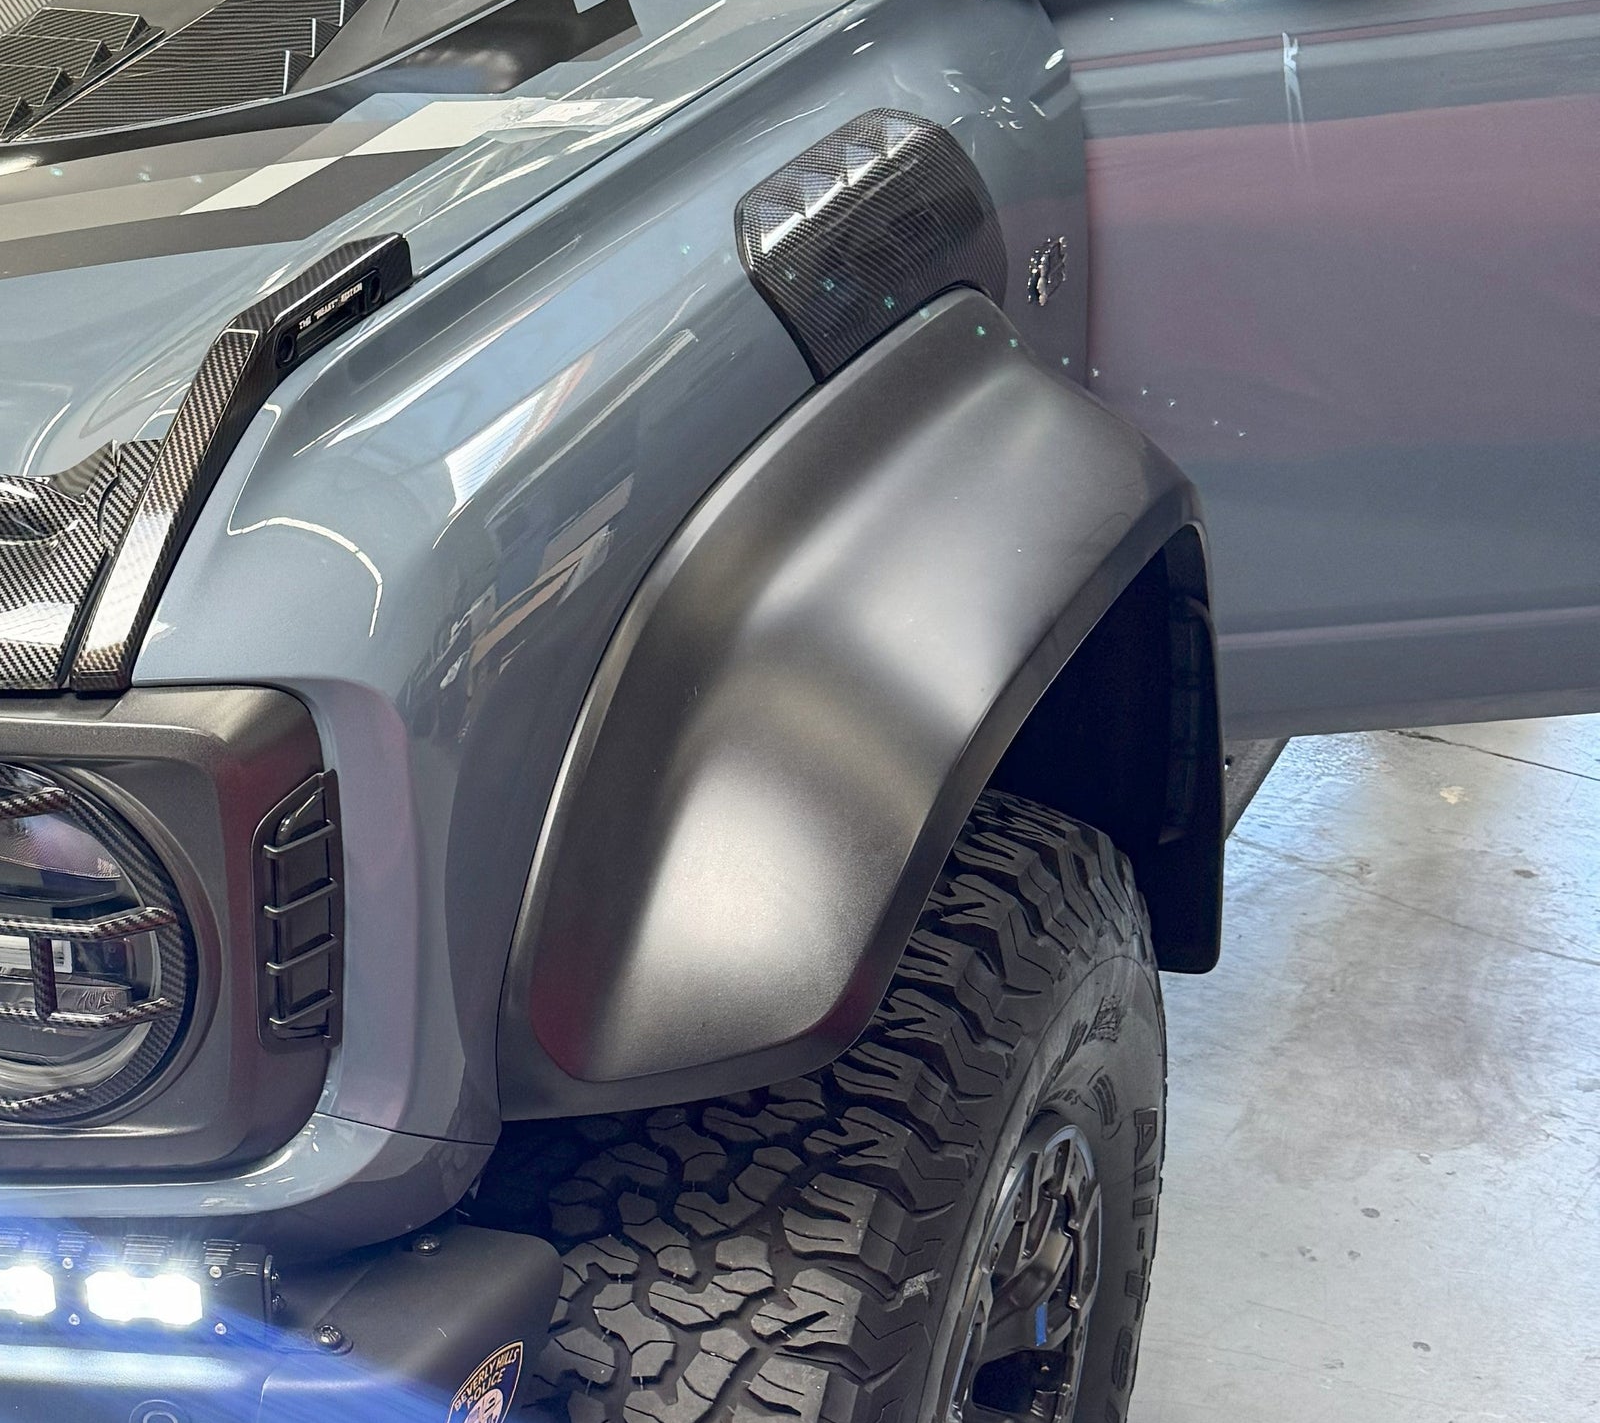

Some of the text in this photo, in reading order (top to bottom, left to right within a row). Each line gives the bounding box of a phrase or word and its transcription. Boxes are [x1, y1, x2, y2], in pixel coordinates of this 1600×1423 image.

[453, 1348, 520, 1412] BEVERLY HILLS
[465, 1367, 506, 1410] POLICE
